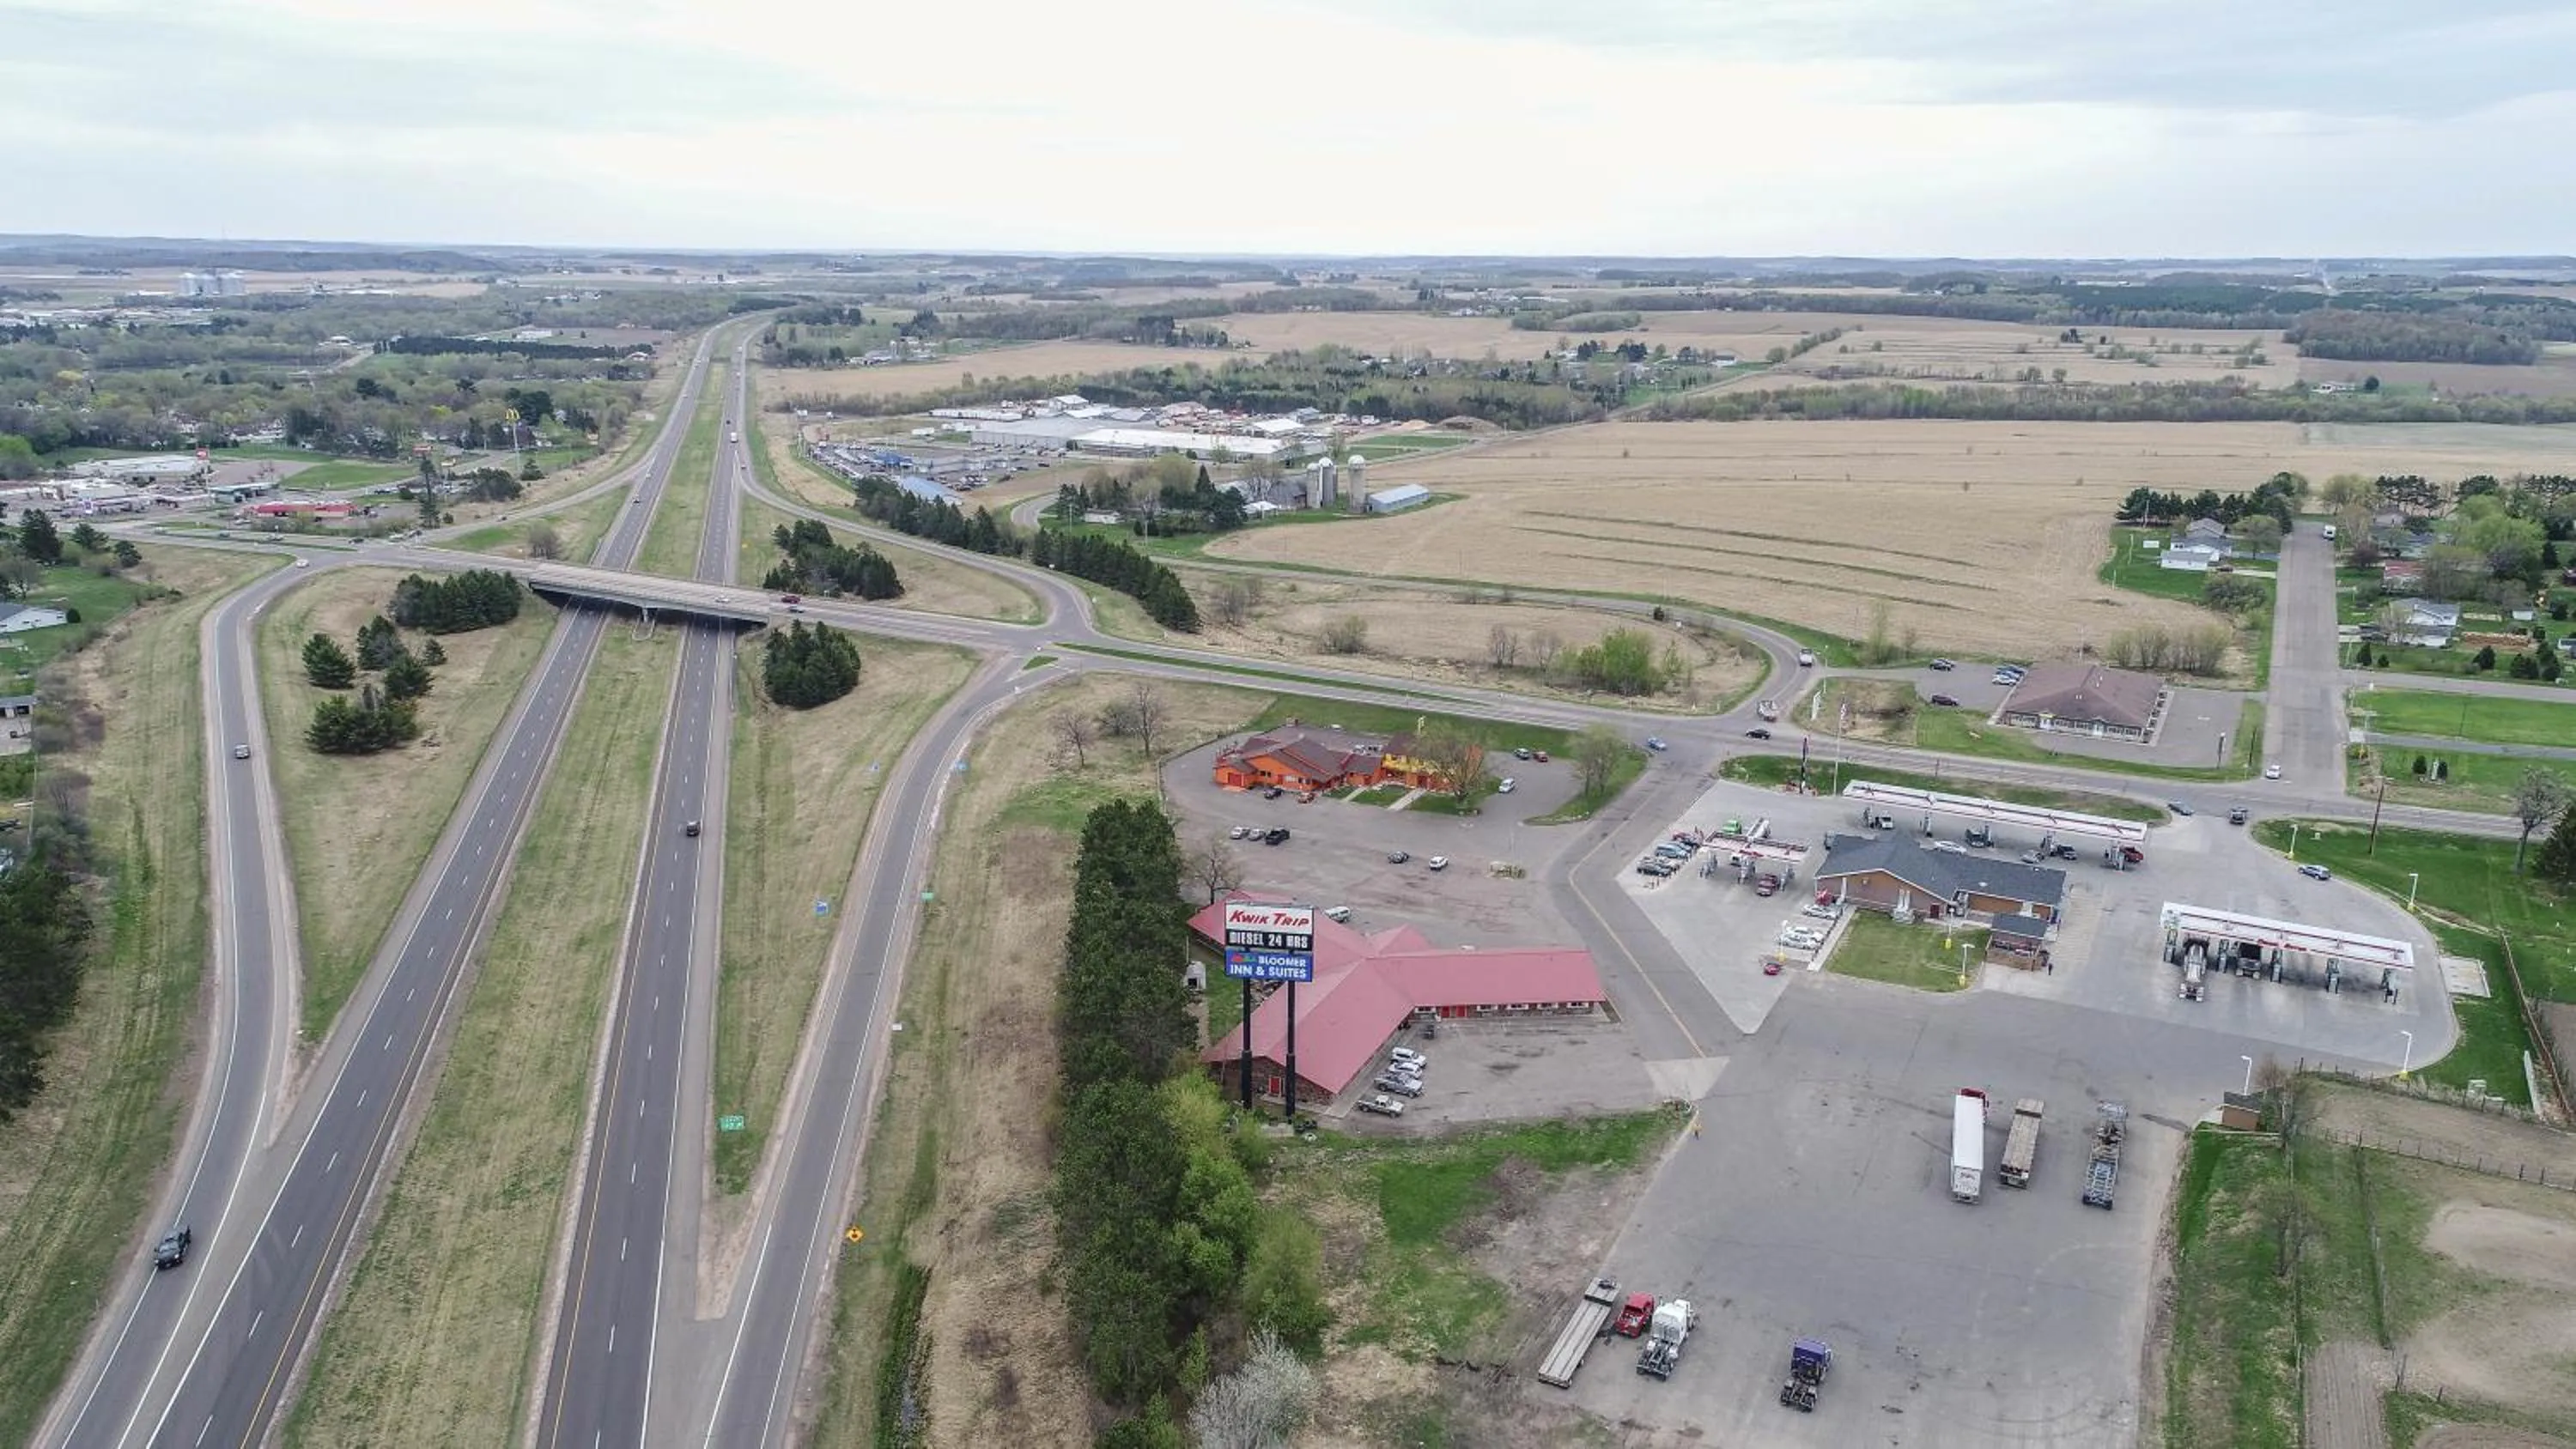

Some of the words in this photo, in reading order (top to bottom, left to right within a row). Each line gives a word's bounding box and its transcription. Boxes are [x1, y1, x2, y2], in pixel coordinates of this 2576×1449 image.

[1273, 912, 1309, 926] TRIP
[1229, 931, 1264, 946] DIESEL
[1268, 934, 1282, 947] 24
[1286, 935, 1309, 949] HRS
[1258, 955, 1306, 967] BLOOMER
[1230, 964, 1253, 976] INN
[1255, 967, 1265, 976] &
[1268, 967, 1306, 979] SUITES
